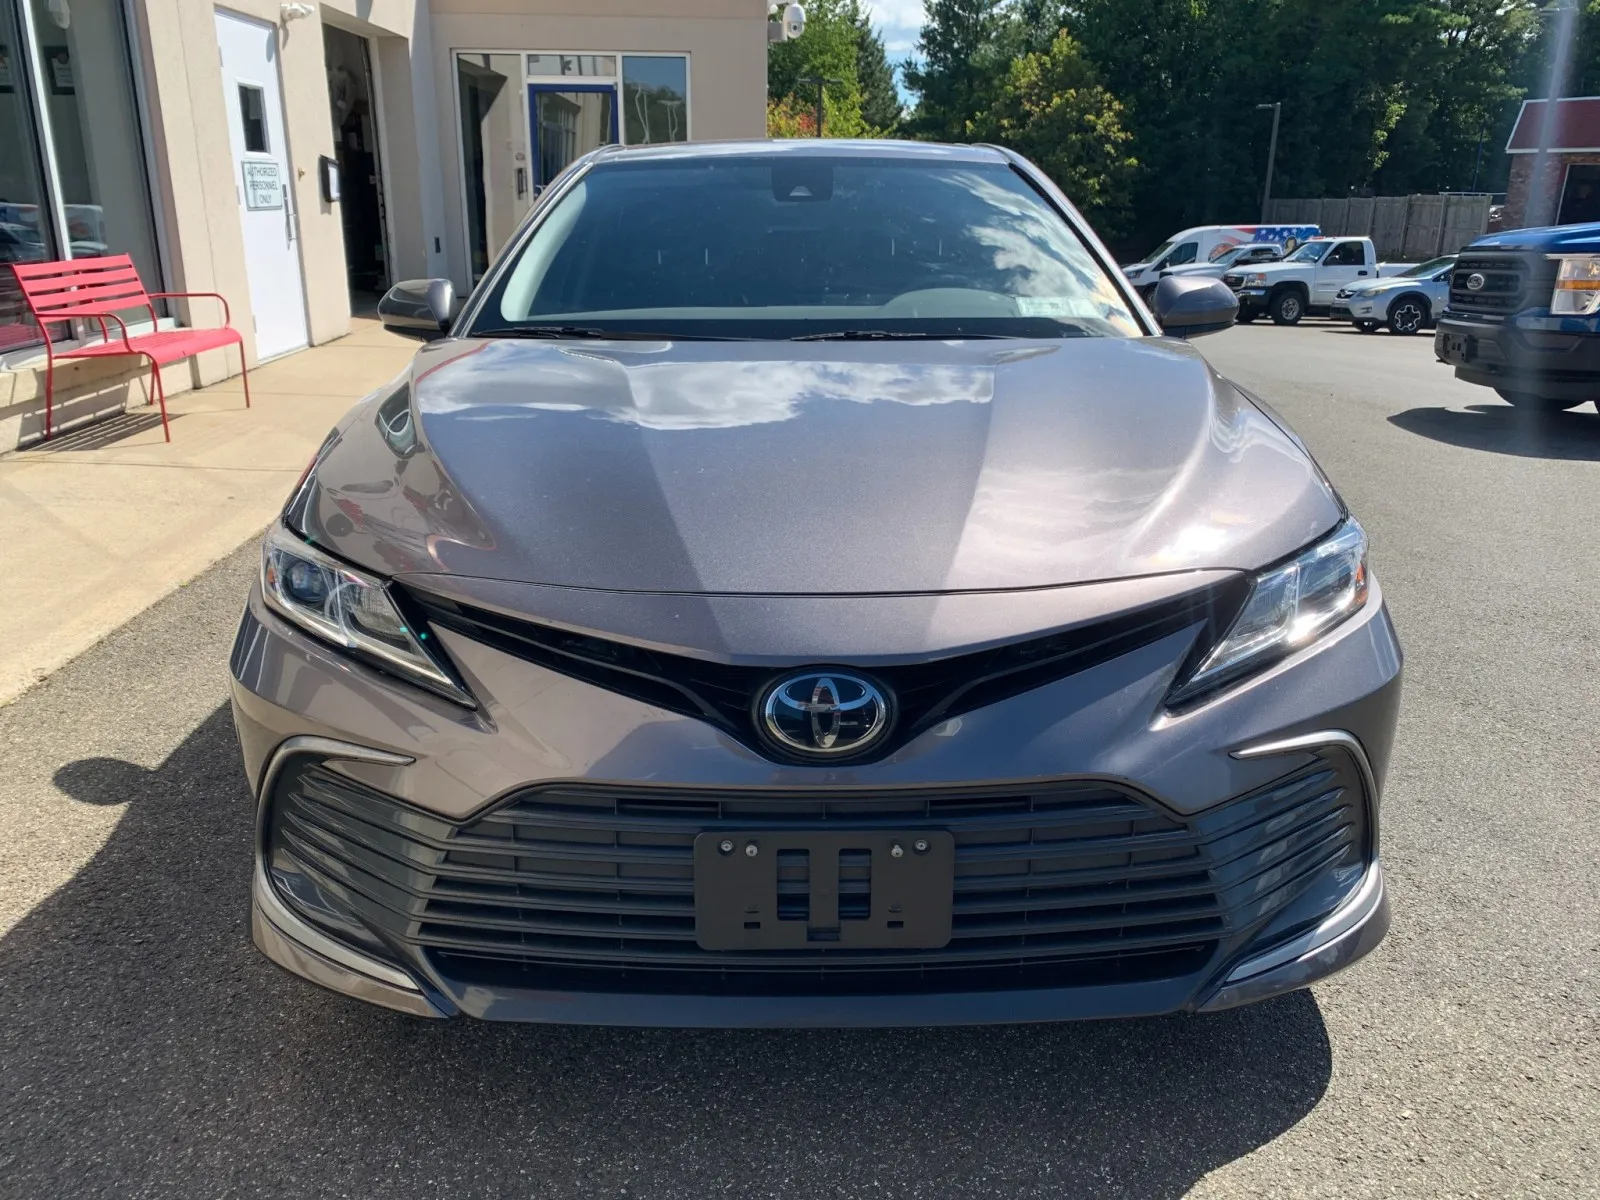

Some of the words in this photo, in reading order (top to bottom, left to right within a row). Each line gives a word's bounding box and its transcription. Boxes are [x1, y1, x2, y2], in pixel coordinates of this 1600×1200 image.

[247, 167, 277, 177] AUTHORIZED
[249, 180, 279, 190] PERSONNEL
[259, 194, 272, 204] ONLY
